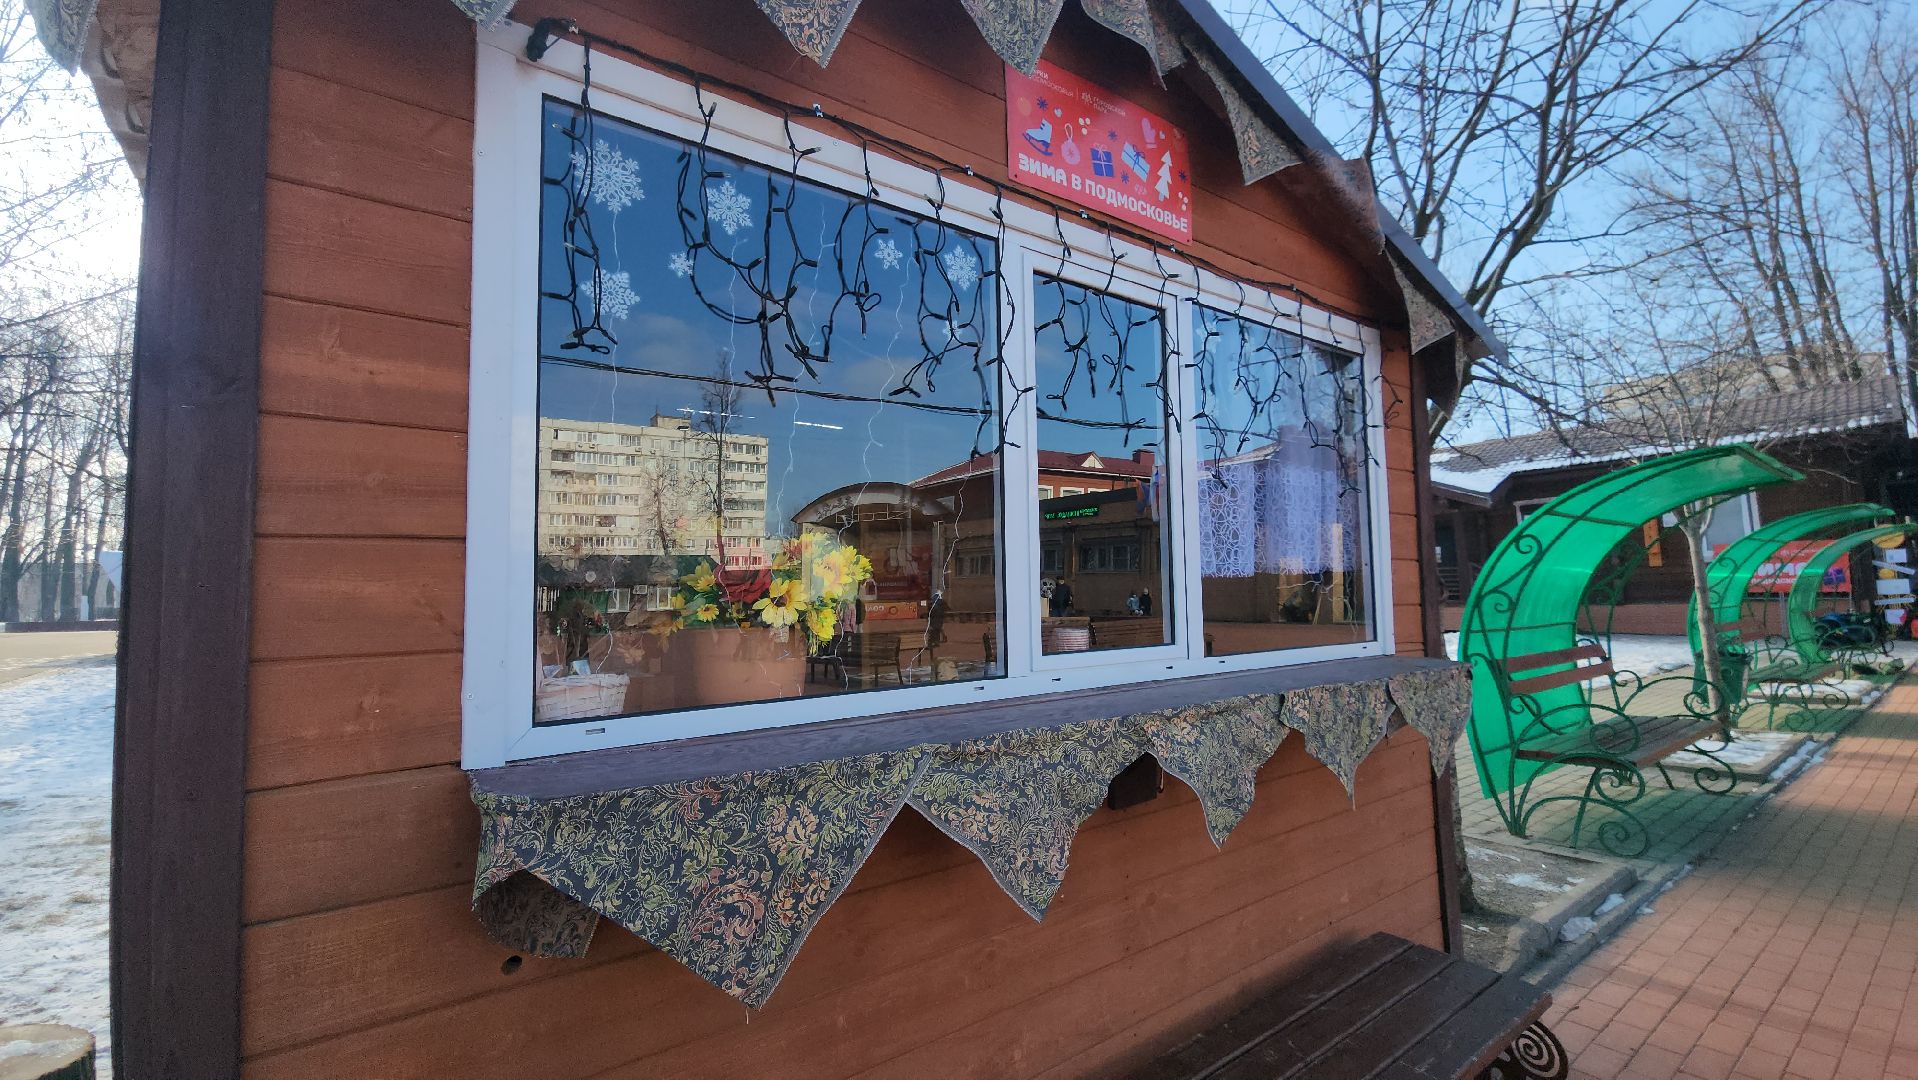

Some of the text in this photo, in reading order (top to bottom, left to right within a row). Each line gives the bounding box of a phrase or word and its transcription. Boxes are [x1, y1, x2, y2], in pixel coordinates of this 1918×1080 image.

[1018, 153, 1188, 232] ЗИМА В ПОДМОСКОВЬЕ
